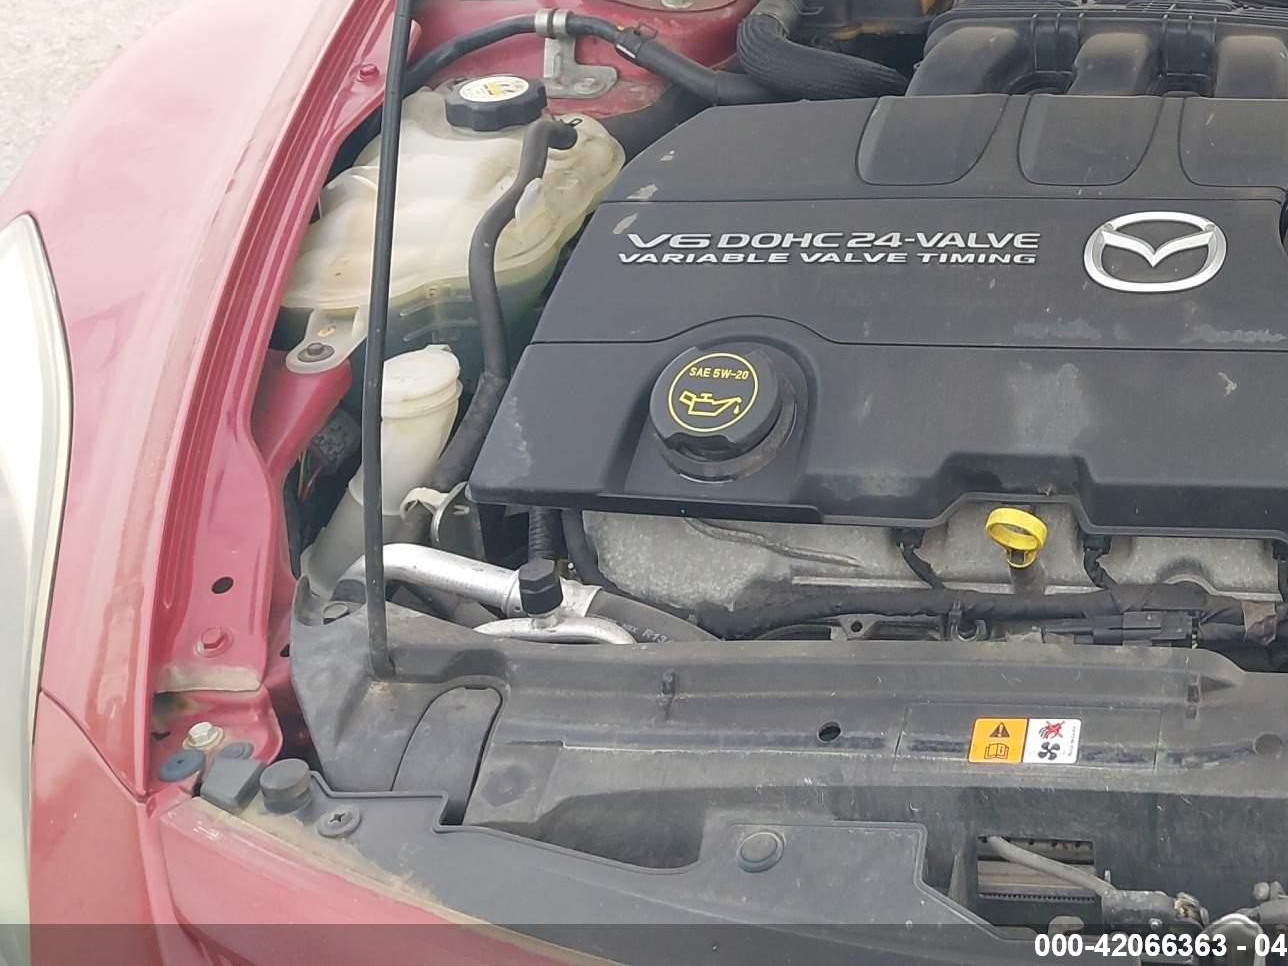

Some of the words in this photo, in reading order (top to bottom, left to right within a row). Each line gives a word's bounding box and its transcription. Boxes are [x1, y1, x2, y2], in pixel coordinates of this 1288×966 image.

[627, 232, 712, 249] V6
[717, 232, 843, 249] DOHC
[846, 232, 1041, 249] 24-VALVE
[618, 252, 790, 264] VARIABLE
[800, 252, 909, 264] VALVE
[916, 252, 1037, 265] TIMING
[689, 367, 711, 378] SAE
[712, 368, 749, 380] 5W-20
